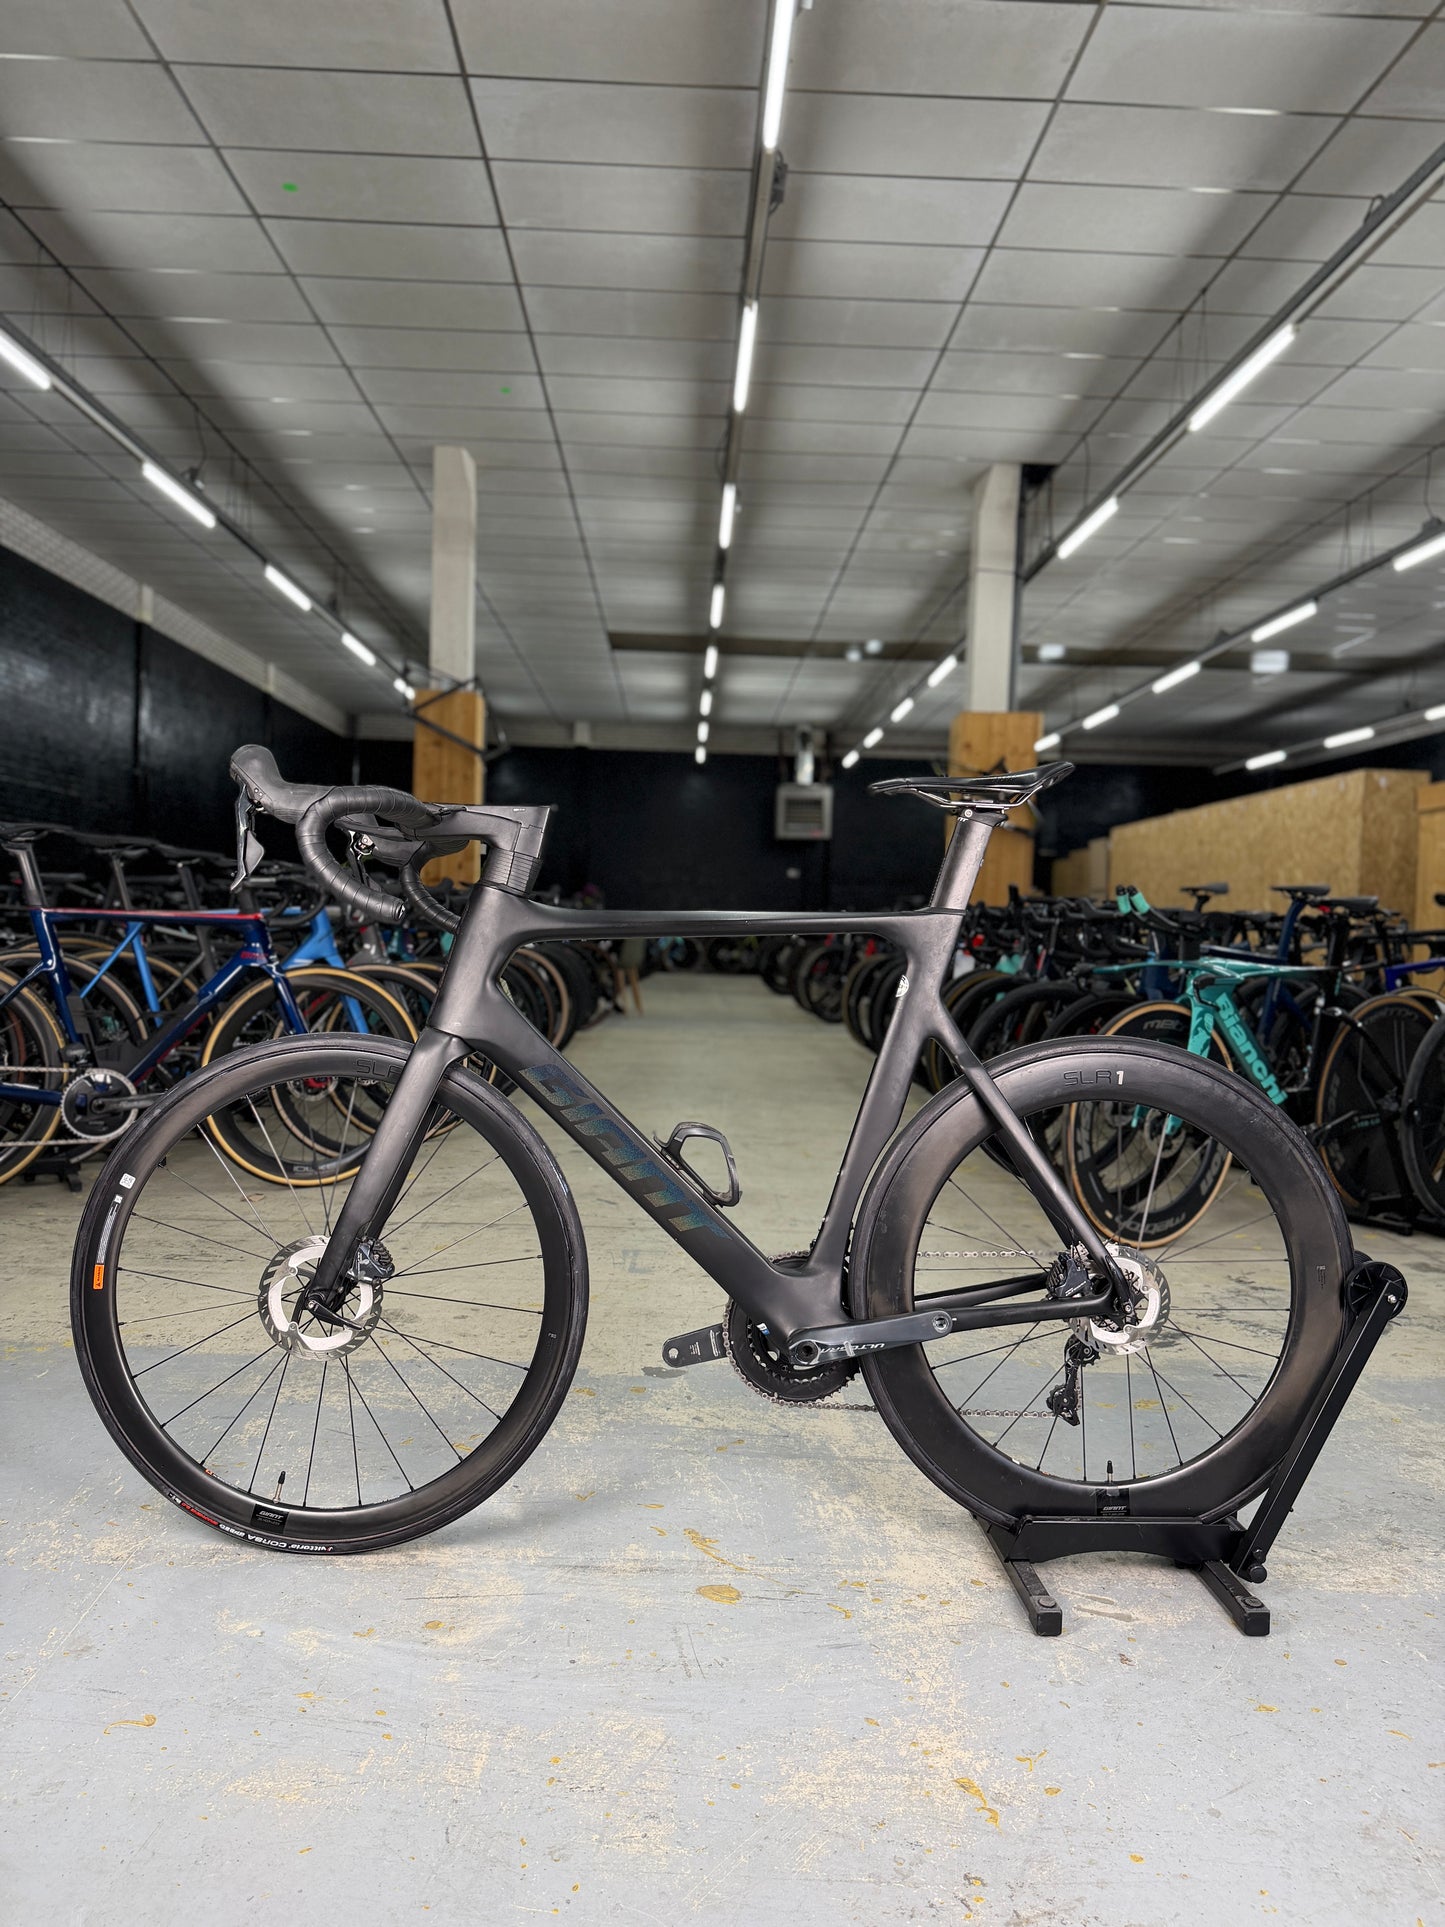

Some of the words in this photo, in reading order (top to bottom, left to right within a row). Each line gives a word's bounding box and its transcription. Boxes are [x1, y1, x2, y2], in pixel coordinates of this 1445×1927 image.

[1215, 992, 1289, 1105] Bianchi
[1063, 1069, 1112, 1087] SLR
[1116, 1070, 1125, 1085] 1
[518, 1063, 733, 1241] GIANT
[259, 1510, 284, 1519] GIANT
[247, 1534, 288, 1548] CORSA
